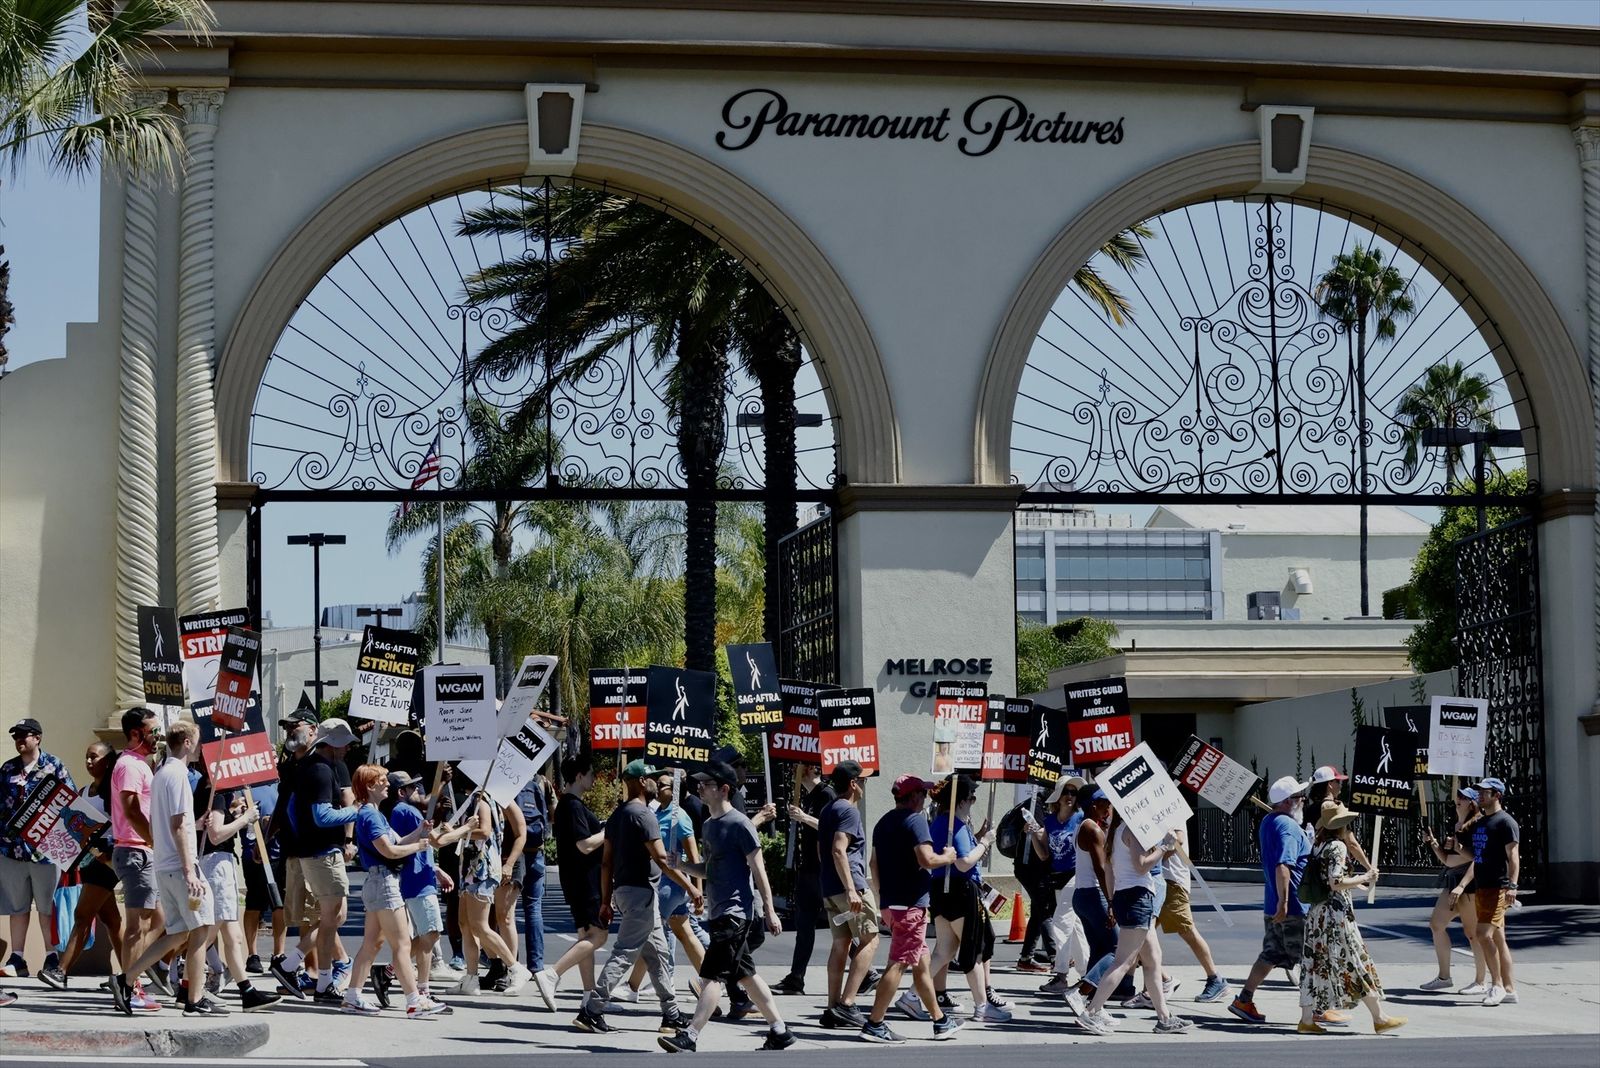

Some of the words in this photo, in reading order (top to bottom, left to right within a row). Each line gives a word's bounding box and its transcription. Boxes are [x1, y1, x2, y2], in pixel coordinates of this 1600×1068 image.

[715, 88, 950, 151] Paramount
[958, 95, 1125, 157] Pictures
[184, 617, 221, 631] WRITERS
[222, 614, 246, 626] GUILD
[186, 633, 226, 656] STRI
[227, 633, 246, 647] WRITERS
[245, 638, 259, 650] GUILD
[385, 652, 396, 660] ON
[227, 659, 248, 673] AMERICA
[361, 655, 415, 676] STRIKE!
[887, 658, 993, 675] MELROSE
[358, 673, 414, 691] NECESSARY
[522, 670, 545, 681] WGAW
[592, 676, 625, 685] WRITERS
[145, 680, 183, 697] STRIKE!
[229, 680, 239, 693] ON
[372, 685, 397, 699] EVIL
[437, 682, 482, 693] WGAW
[781, 684, 815, 696] WRITERS
[909, 681, 937, 698] GA
[939, 687, 966, 696] WRITERS
[966, 687, 985, 697] GUILD
[1069, 687, 1101, 699] WRITERS
[1101, 685, 1123, 695] GUILD
[214, 692, 247, 719] STRIKE!
[361, 694, 388, 708] DEEZ
[755, 704, 766, 712] ON
[804, 698, 812, 706] OF
[820, 697, 851, 708] WRITERS
[851, 696, 871, 706] GUILD
[1093, 698, 1102, 706] OF
[789, 705, 819, 717] AMERIC
[843, 708, 851, 716] OF
[938, 704, 983, 722] STRIKE!
[1006, 704, 1030, 713] GUILD
[1082, 705, 1115, 718] AMERICA
[740, 710, 784, 726] STRIKE!
[832, 717, 863, 728] AMERICA
[1441, 711, 1476, 721] WGAW
[594, 722, 646, 741] STRIKE
[798, 723, 813, 734] ON
[1095, 723, 1108, 734] ON
[515, 731, 541, 754] GAW
[672, 736, 686, 746] ON
[772, 732, 821, 754] STRIK
[843, 734, 856, 745] ON
[1074, 732, 1131, 755] STRIKE!
[230, 742, 246, 755] ON
[647, 742, 710, 763] STRIKE!
[823, 745, 876, 766] STRIKE!
[1034, 759, 1044, 767] ON
[1172, 753, 1192, 776] WRITERS
[1187, 740, 1201, 756] GUILD
[209, 751, 273, 781] STRIKE!
[1185, 748, 1221, 789] STRIKE!
[1028, 764, 1060, 783] RIKE!
[1113, 761, 1148, 791] WGAW
[1153, 783, 1165, 798] UP
[1375, 787, 1388, 796] ON
[14, 799, 41, 829] WRITERS
[38, 780, 56, 800] GUILD
[1351, 791, 1409, 810] STRIKE!
[27, 788, 73, 843] STRIKE!
